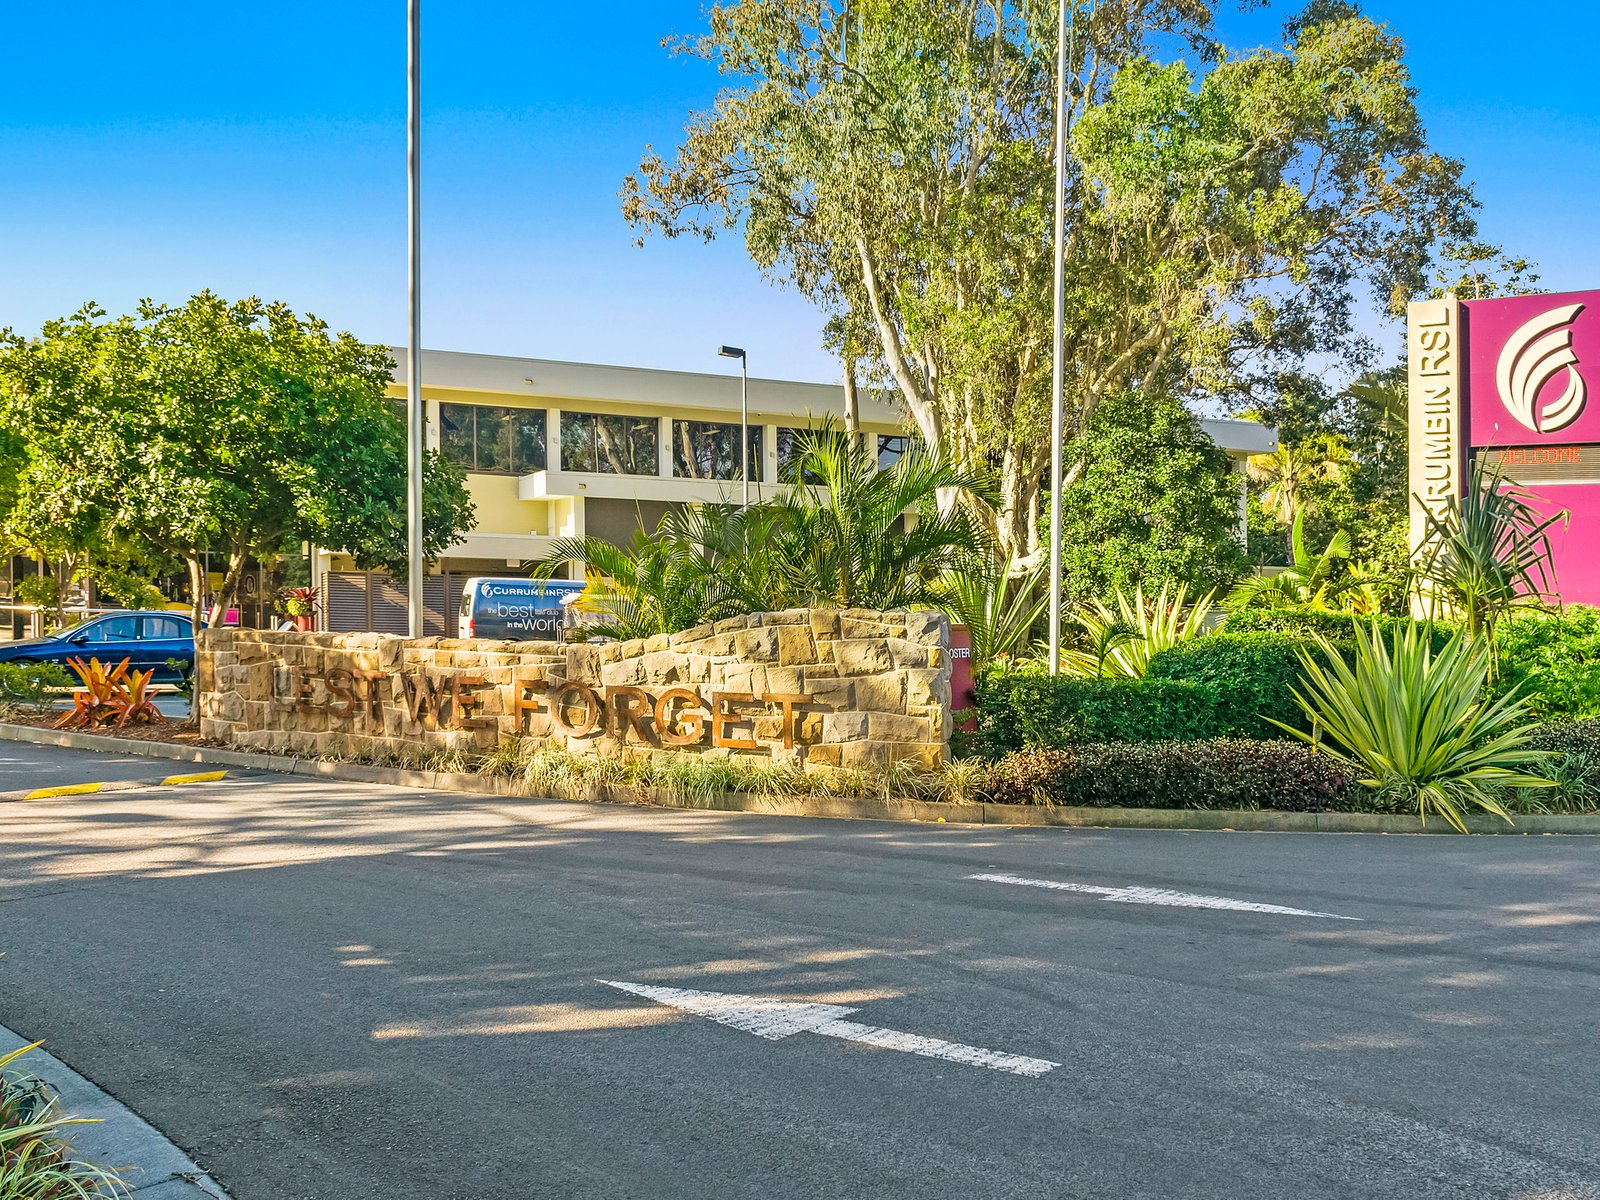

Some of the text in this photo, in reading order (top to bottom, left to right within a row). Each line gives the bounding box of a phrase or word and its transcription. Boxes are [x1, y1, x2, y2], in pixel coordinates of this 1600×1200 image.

[1418, 307, 1451, 570] RRUMBIN RSL
[1498, 447, 1582, 464] WELCOME
[498, 602, 534, 618] best
[268, 663, 813, 750] LEST WE FORGET
